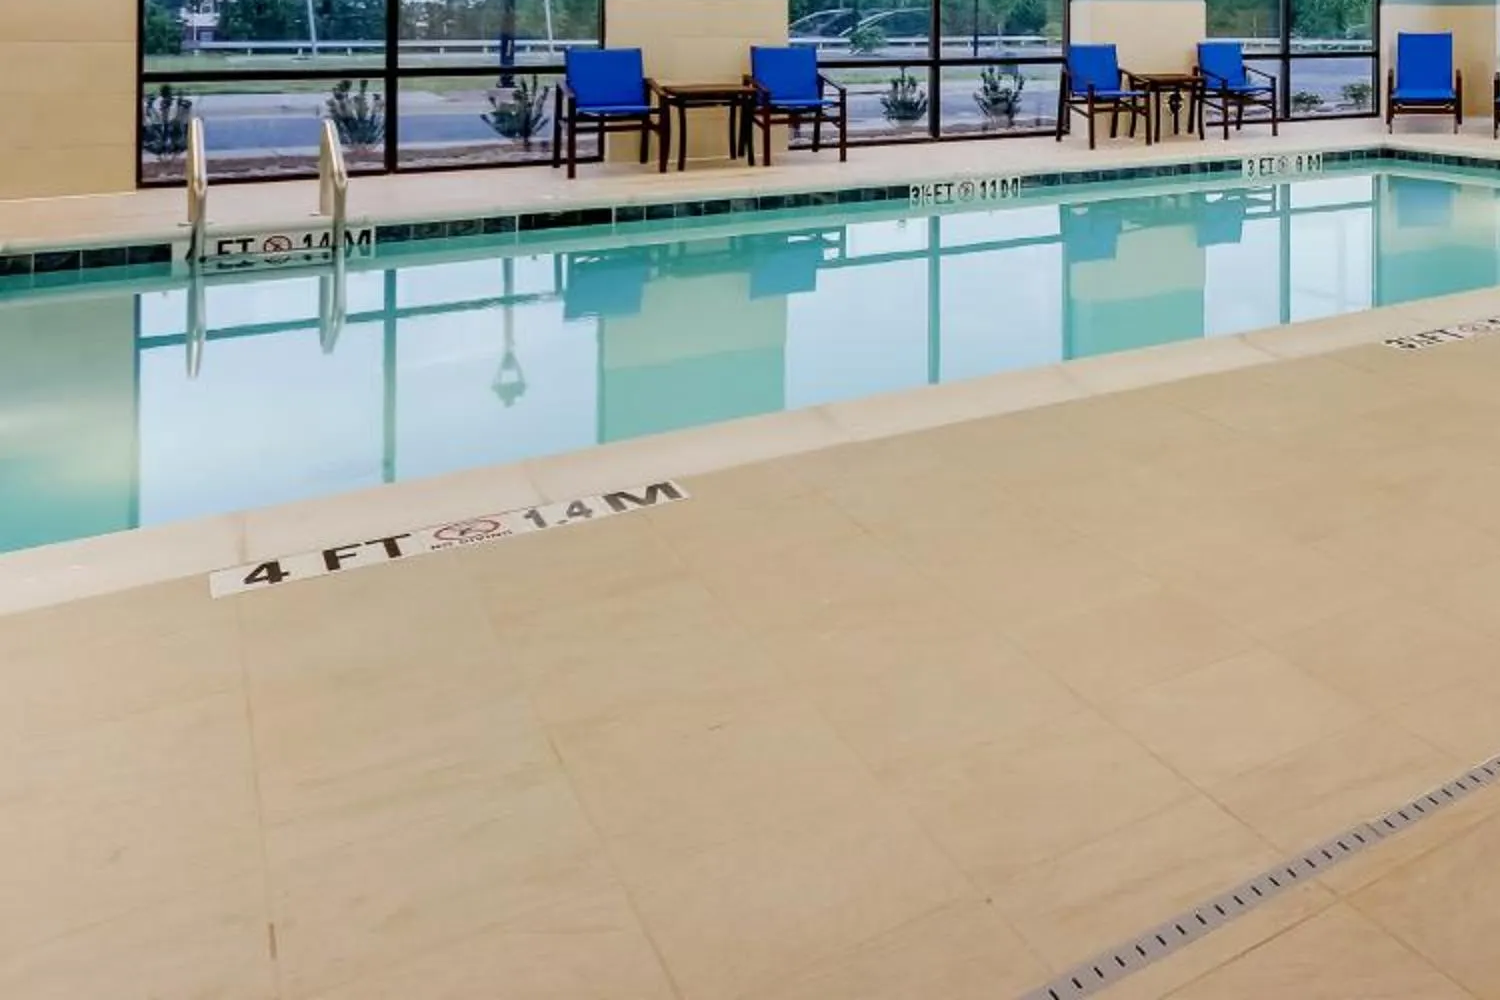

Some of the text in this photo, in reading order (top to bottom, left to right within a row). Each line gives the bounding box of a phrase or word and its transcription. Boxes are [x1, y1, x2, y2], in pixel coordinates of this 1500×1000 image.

[243, 560, 290, 584] 4
[322, 533, 411, 571] FT
[602, 482, 683, 512] M
